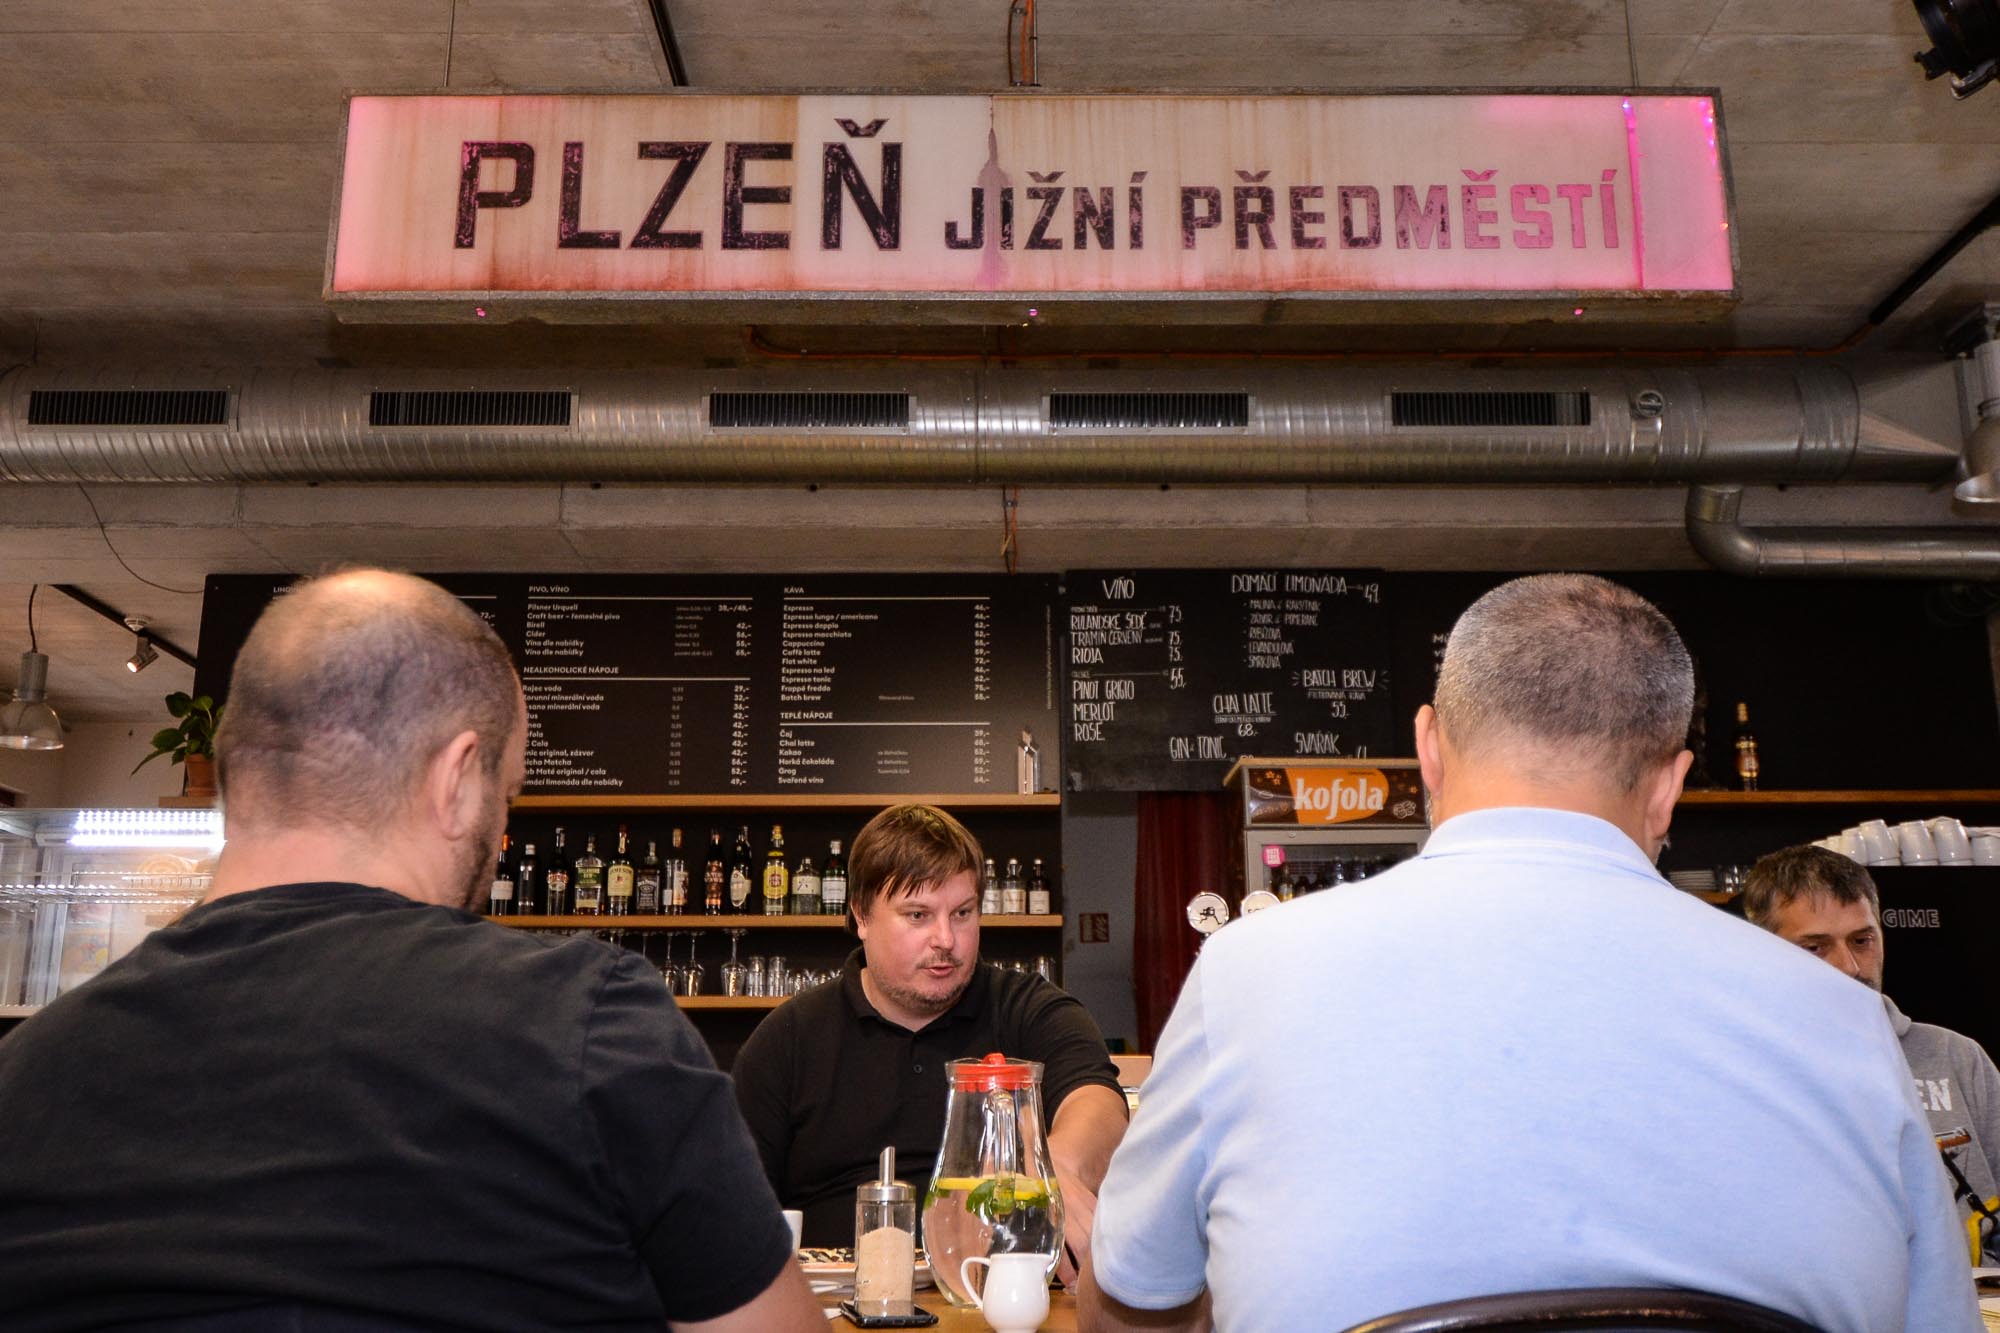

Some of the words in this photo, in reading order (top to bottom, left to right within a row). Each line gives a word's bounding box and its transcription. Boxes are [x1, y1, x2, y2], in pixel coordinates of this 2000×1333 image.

[454, 118, 904, 252] PLZEŇ
[944, 169, 1148, 251] JIŽNÍ
[1180, 169, 1619, 250] PŘEDMĚSTÍ
[1232, 572, 1278, 594] DOMÁCÍ
[1286, 572, 1348, 595] LIMONÁDA
[784, 586, 804, 594] KÁVA
[1102, 576, 1135, 600] VÍNO
[552, 604, 578, 612] Urquell
[814, 622, 839, 630] doppio
[556, 640, 584, 648] nabídky
[782, 640, 824, 648] Cappuccino
[554, 648, 584, 656] nabídky
[1072, 647, 1104, 664] RIOJA
[524, 666, 587, 674] NEALKOHOLICKÉ
[588, 666, 619, 674] NÁPOJE
[782, 676, 812, 684] Espresso
[1302, 668, 1336, 688] BATCH
[1343, 668, 1376, 688] BREW
[1072, 680, 1099, 700] PINOT
[1106, 680, 1134, 700] GRIGIO
[1213, 694, 1240, 714] CHAI
[1243, 692, 1278, 714] LATTE
[1073, 701, 1116, 722] MERLOT
[780, 730, 792, 738] Čaj
[1170, 736, 1190, 760] GIN
[1197, 736, 1226, 760] TONIC
[779, 758, 800, 766] Horká
[556, 768, 584, 776] original
[778, 768, 796, 776] Grog
[582, 778, 592, 786] dle
[594, 778, 623, 787] nabídky
[1294, 778, 1384, 821] kofola
